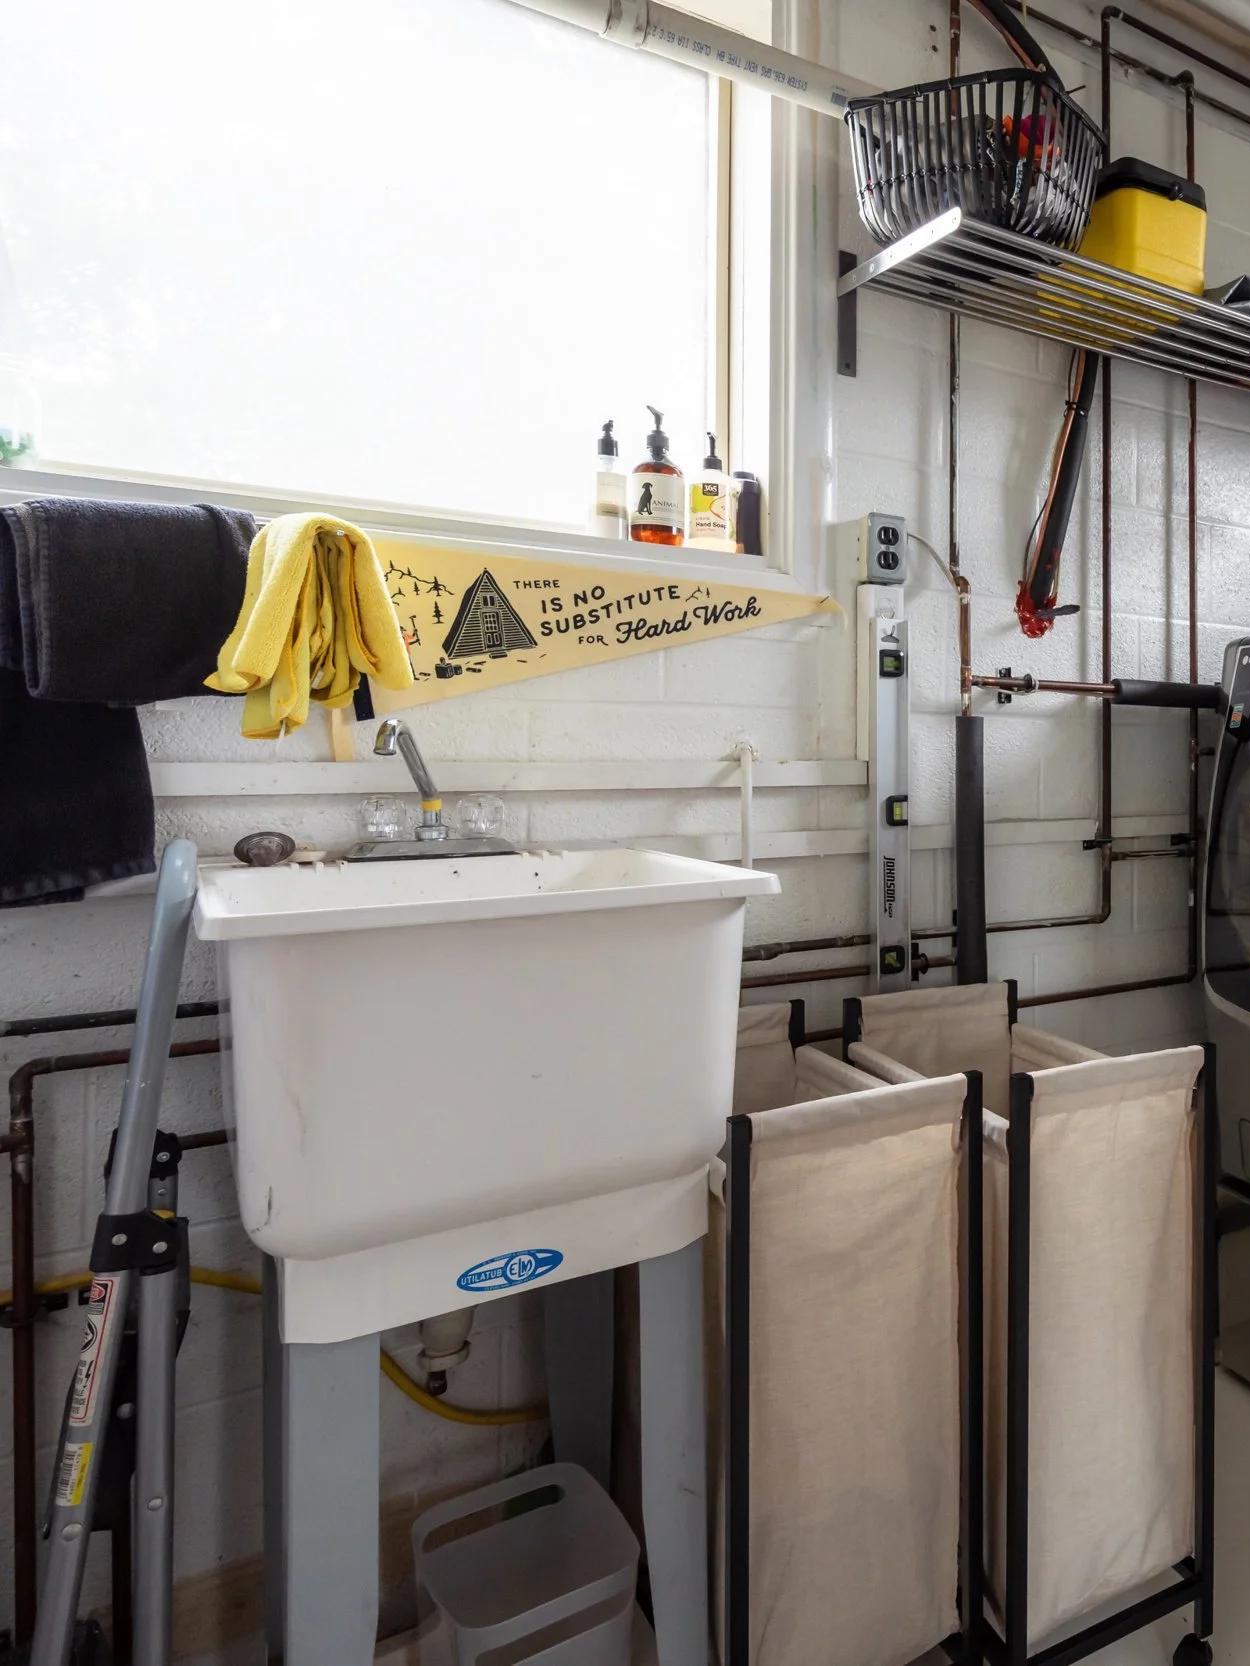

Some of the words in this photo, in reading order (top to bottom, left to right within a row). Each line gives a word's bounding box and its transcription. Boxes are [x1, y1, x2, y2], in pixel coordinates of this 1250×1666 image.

[692, 41, 712, 57] CLASS
[716, 49, 725, 62] BH
[726, 53, 742, 68] TYPE
[743, 60, 758, 74] VENT
[761, 65, 772, 78] GAS
[787, 75, 809, 92] SYSTEM
[703, 484, 718, 493] 365
[512, 578, 560, 590] THERE
[540, 598, 562, 615] IS
[573, 586, 606, 608] NO
[539, 584, 681, 638] SUBSTITUTE
[577, 634, 609, 647] FOR
[614, 611, 693, 645] Hard
[691, 595, 764, 627] Work
[883, 855, 896, 902] JOHNSON
[460, 1268, 503, 1286] UTILATUB
[509, 1256, 534, 1279] ELM
